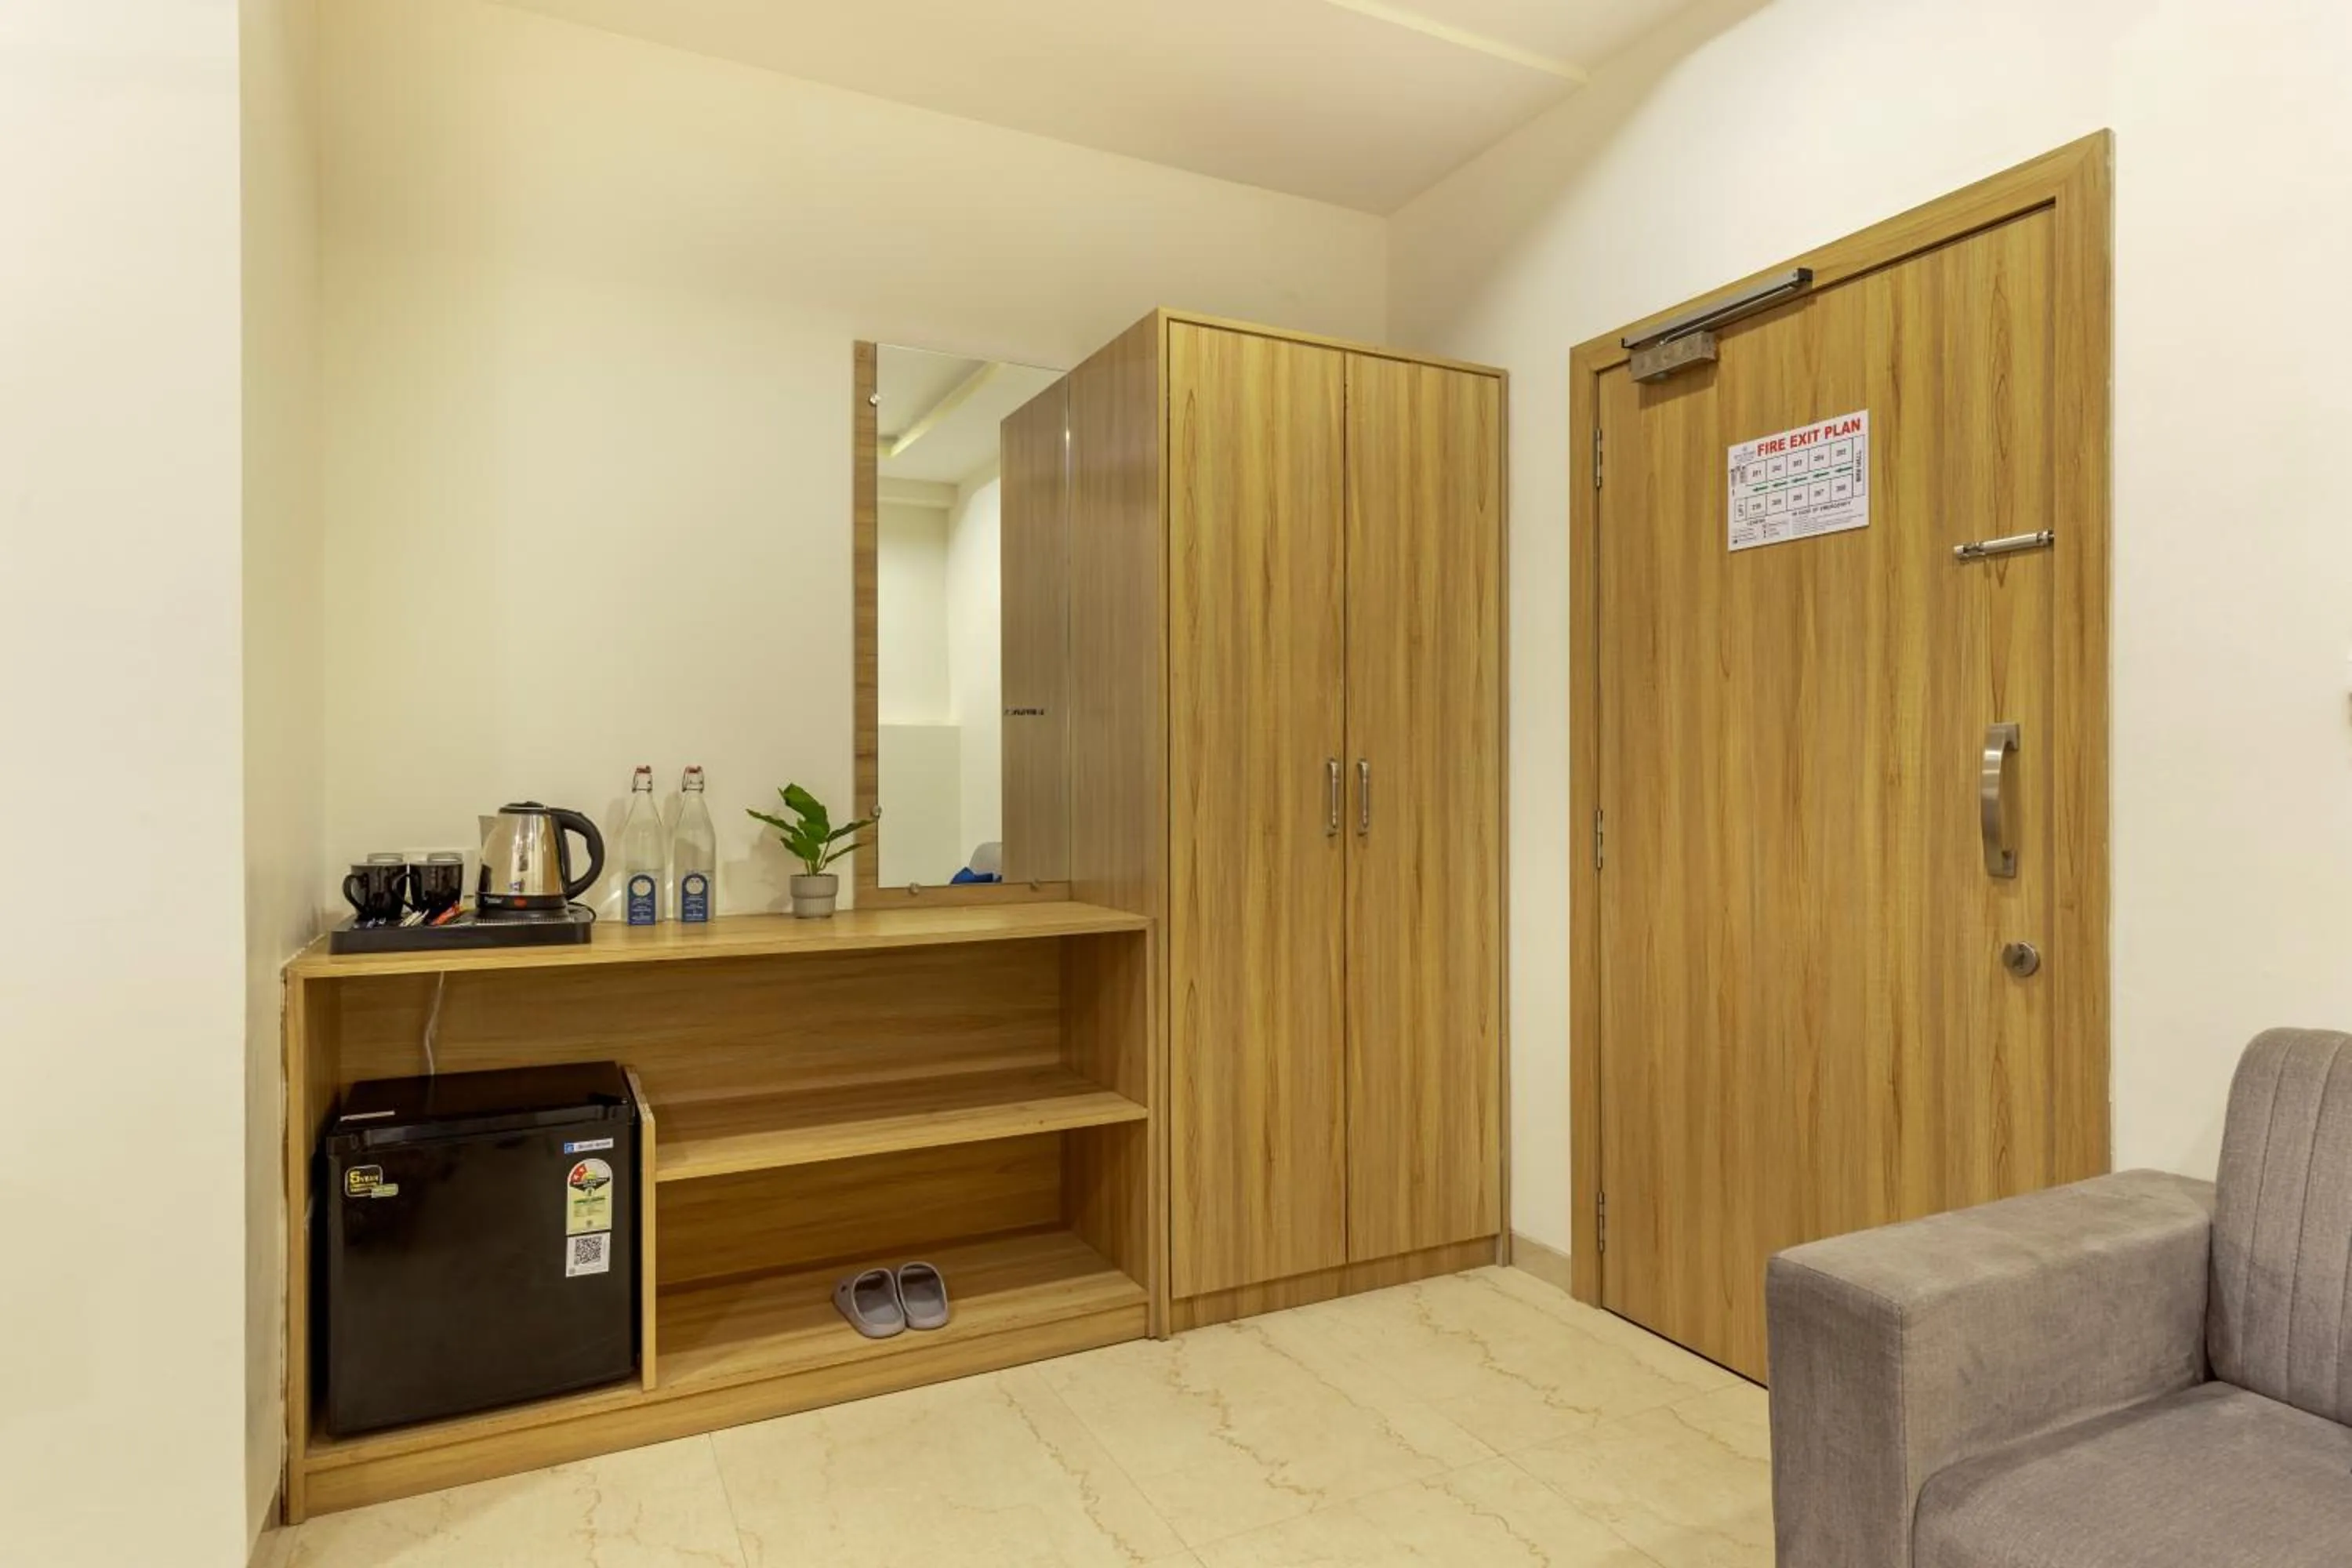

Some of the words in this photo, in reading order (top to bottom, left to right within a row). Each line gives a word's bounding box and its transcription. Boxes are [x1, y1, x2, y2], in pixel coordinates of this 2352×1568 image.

[1757, 438, 1786, 456] FIRE
[1790, 430, 1820, 448] EXIT
[1824, 419, 1861, 439] PLAN
